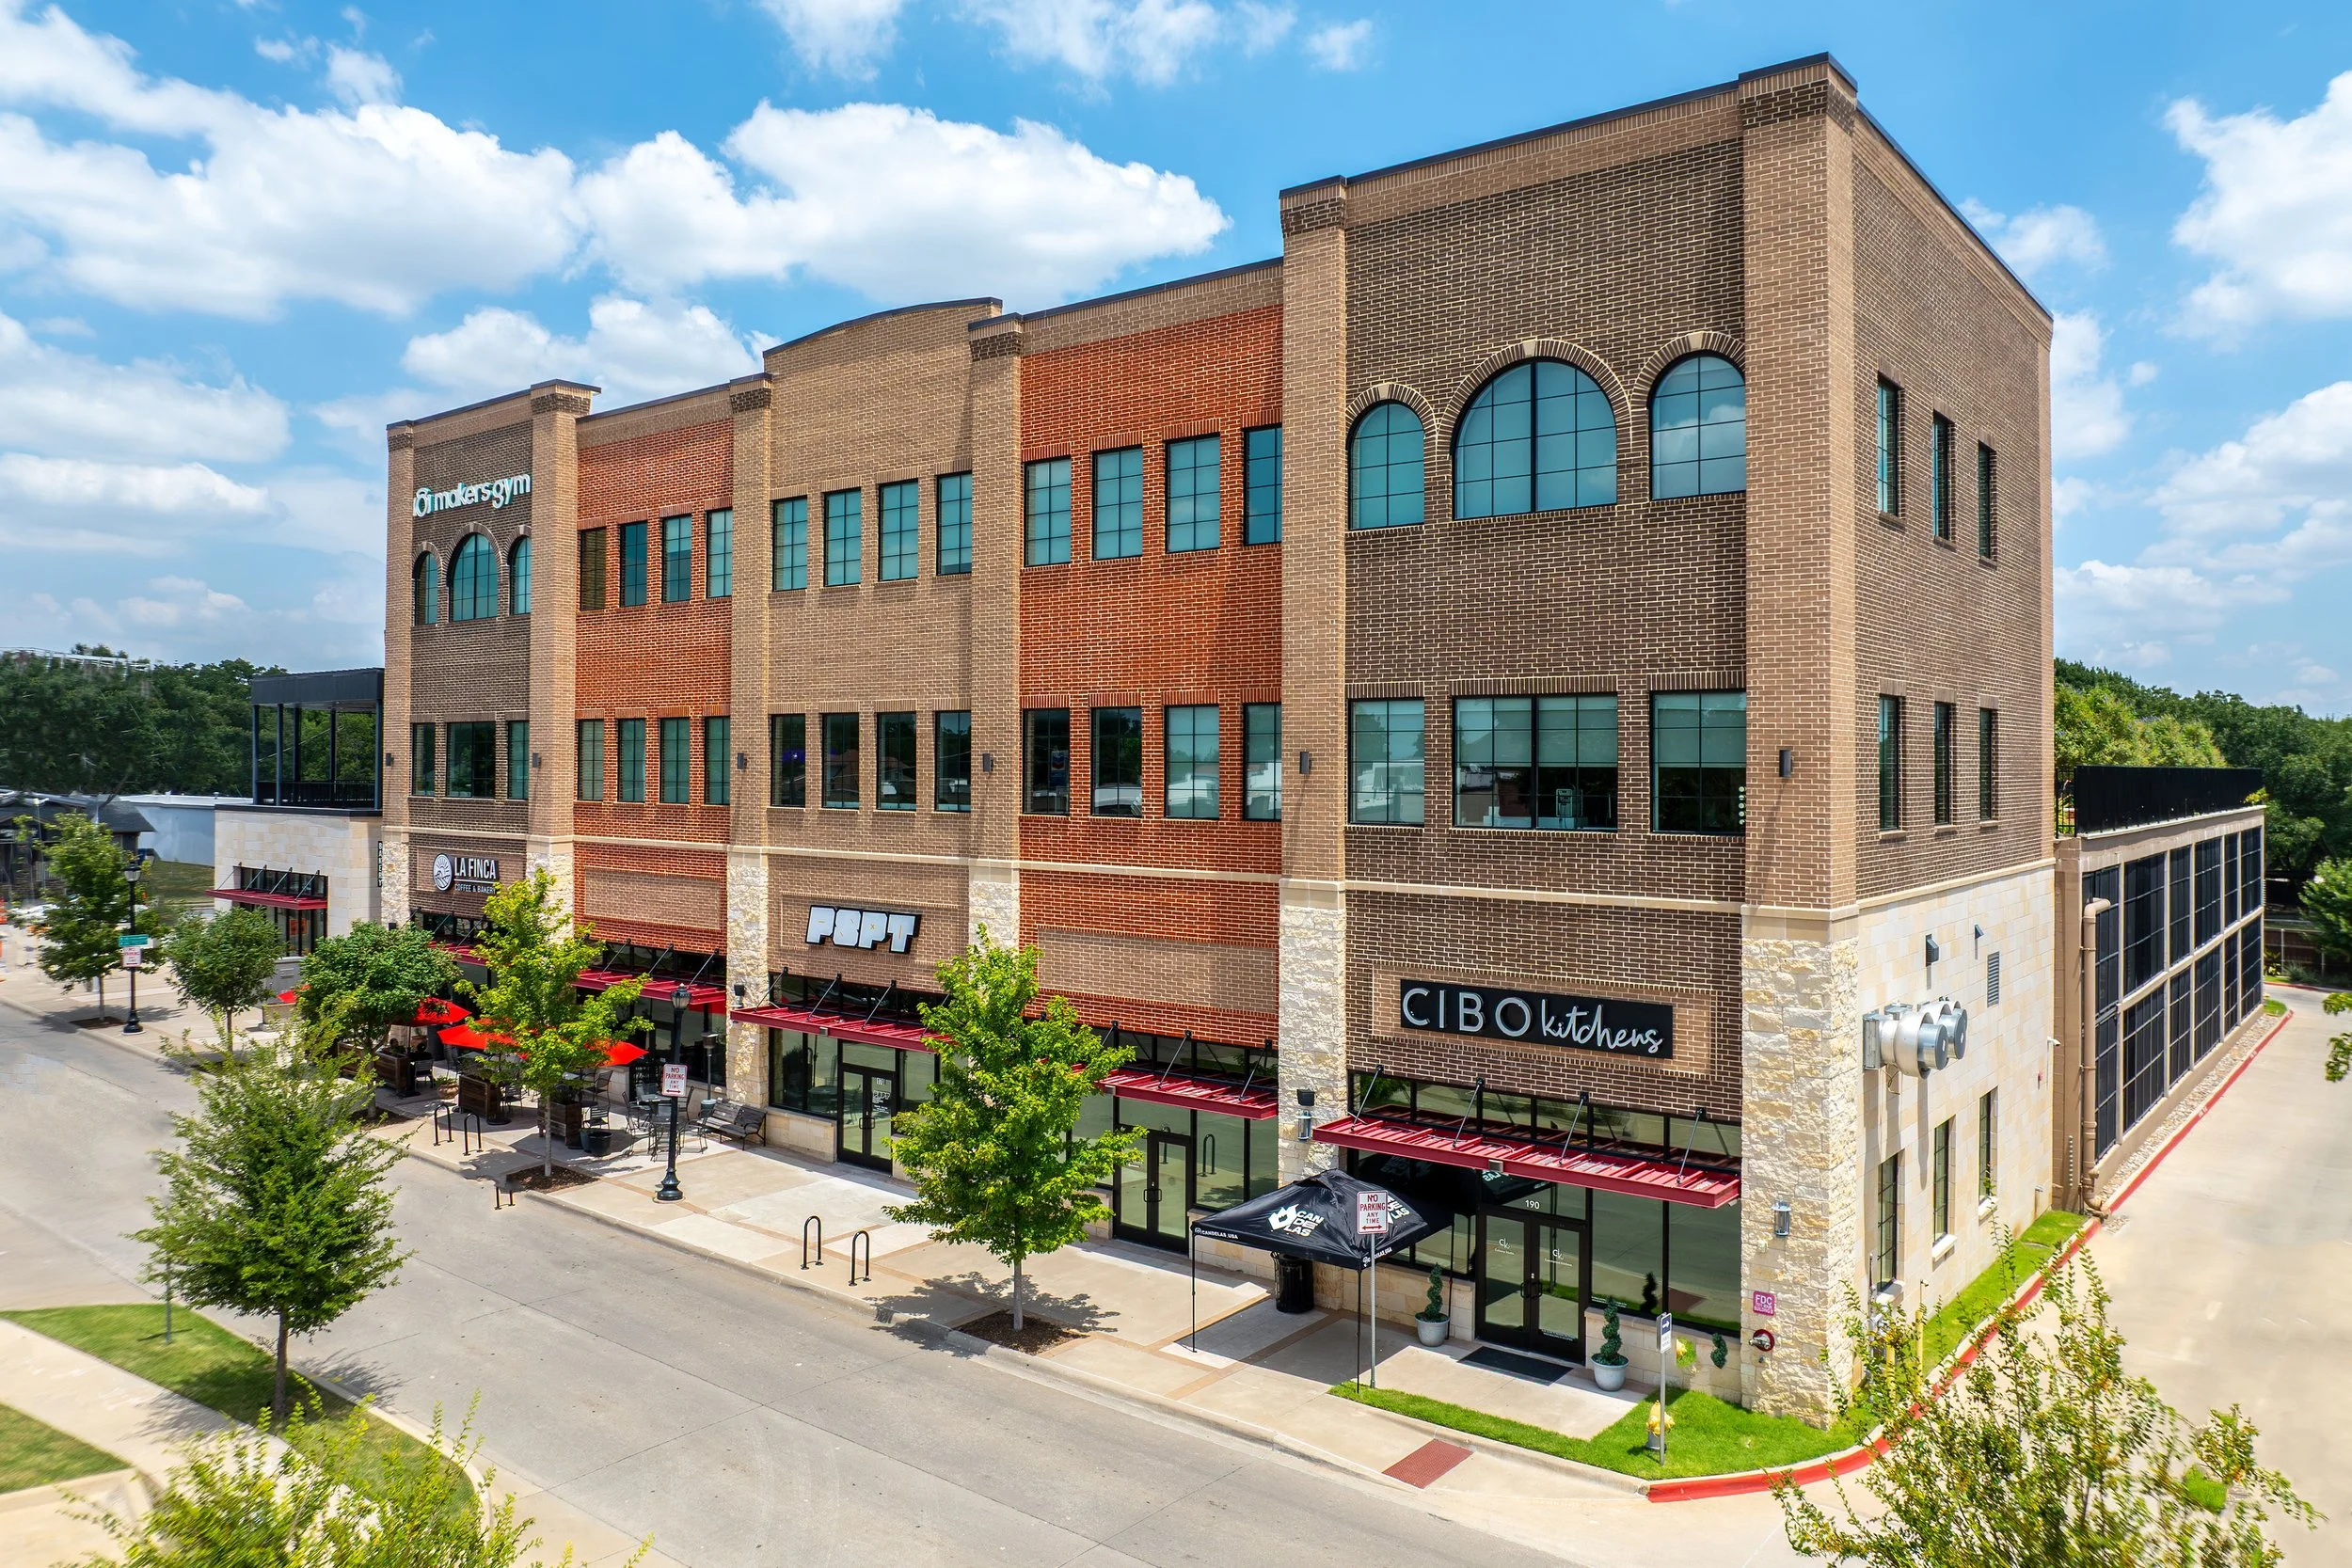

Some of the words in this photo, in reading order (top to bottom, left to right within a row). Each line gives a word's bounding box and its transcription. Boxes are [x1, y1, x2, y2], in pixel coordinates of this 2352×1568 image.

[454, 857, 467, 877] LA
[469, 858, 497, 879] FINCA
[454, 883, 471, 893] COFFEE
[1403, 988, 1533, 1037] CIBO
[1540, 998, 1664, 1054] kitchens
[1359, 1203, 1386, 1212] PARKING
[1525, 1199, 1540, 1210] 190
[1296, 1211, 1325, 1224] CAN
[1293, 1218, 1318, 1229] DE
[1283, 1226, 1312, 1237] LAS
[1756, 1294, 1772, 1306] FDC
